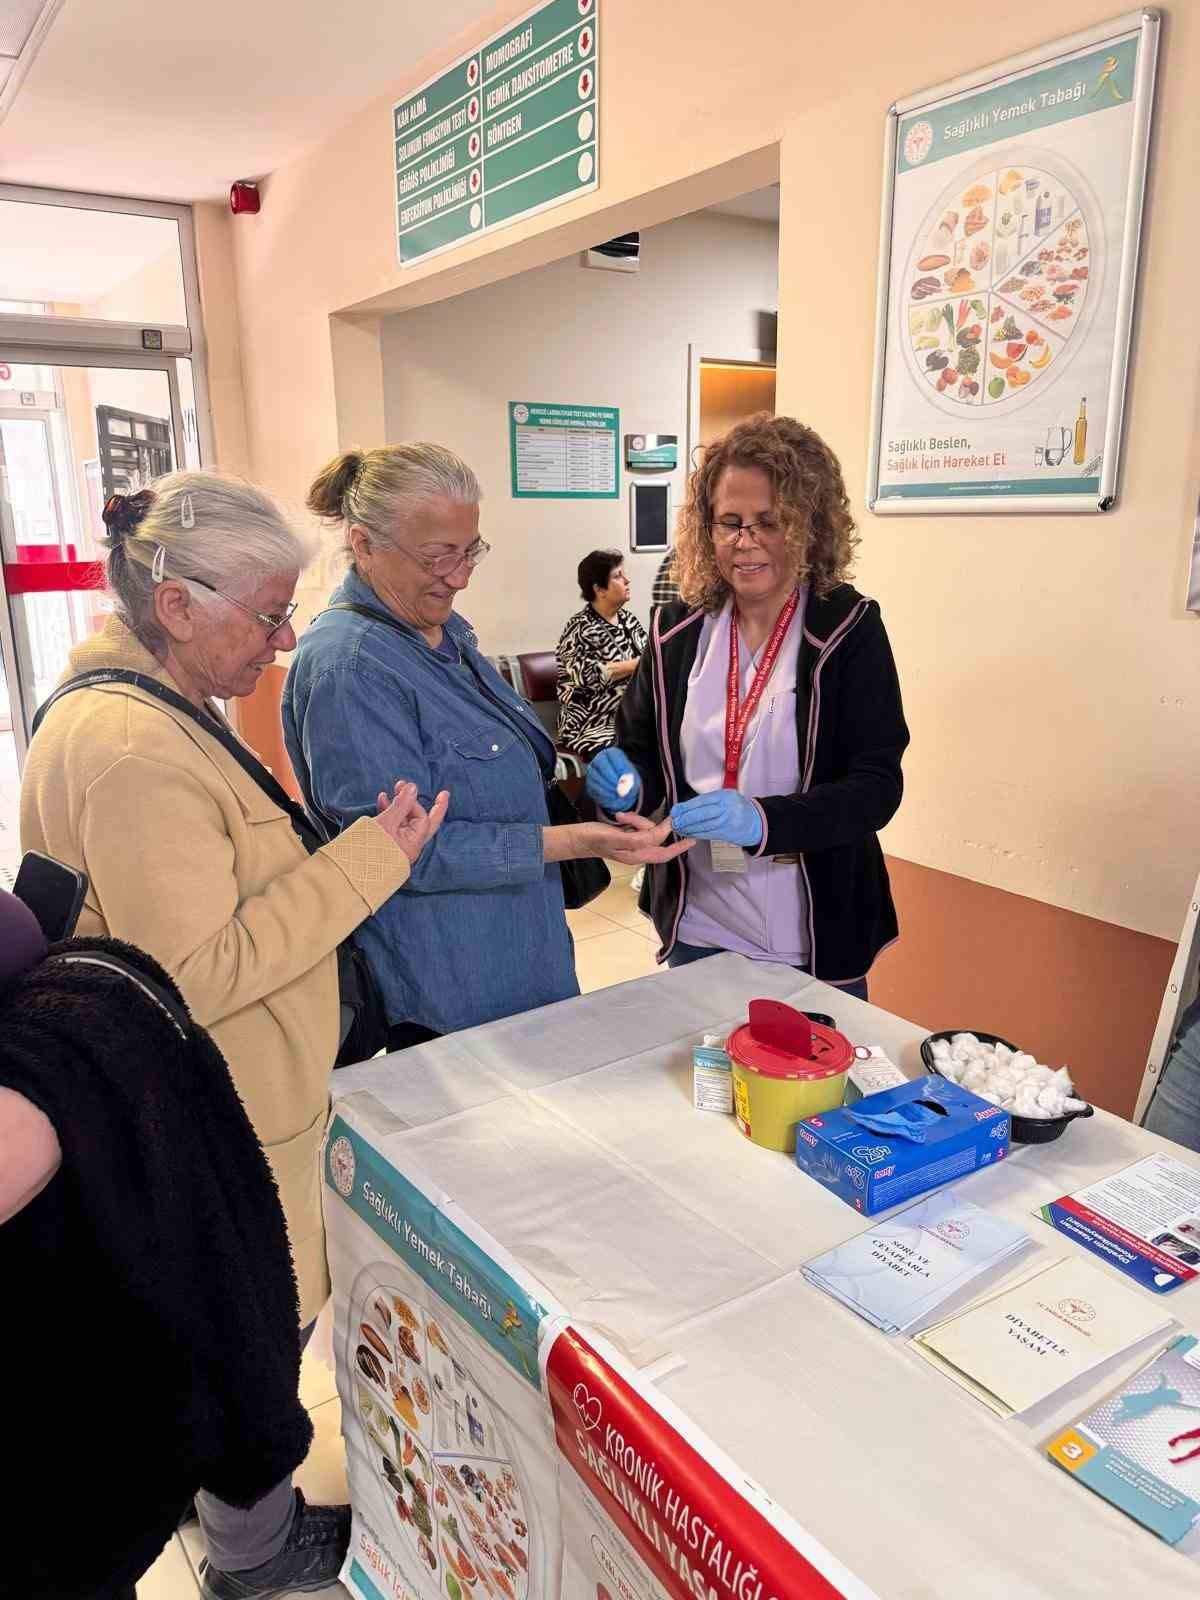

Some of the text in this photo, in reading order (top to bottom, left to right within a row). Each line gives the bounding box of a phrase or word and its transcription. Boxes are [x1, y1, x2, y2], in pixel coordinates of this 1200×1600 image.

[487, 81, 510, 112] KEMİK
[943, 81, 1087, 140] Sağlıklı Yemek Tabağı
[487, 112, 522, 148] RÖNTGEN
[887, 452, 1006, 473] Sağlık İçin Hareket Et
[888, 436, 971, 455] Sağlıklı Beslen,
[363, 1181, 494, 1321] Sağlıklı Yemek Tabağı
[1004, 1313, 1070, 1358] DİYABETLE
[605, 1423, 665, 1509] KRONİK
[1061, 1441, 1083, 1459] 3
[575, 1428, 661, 1552] SAĞLIKLI
